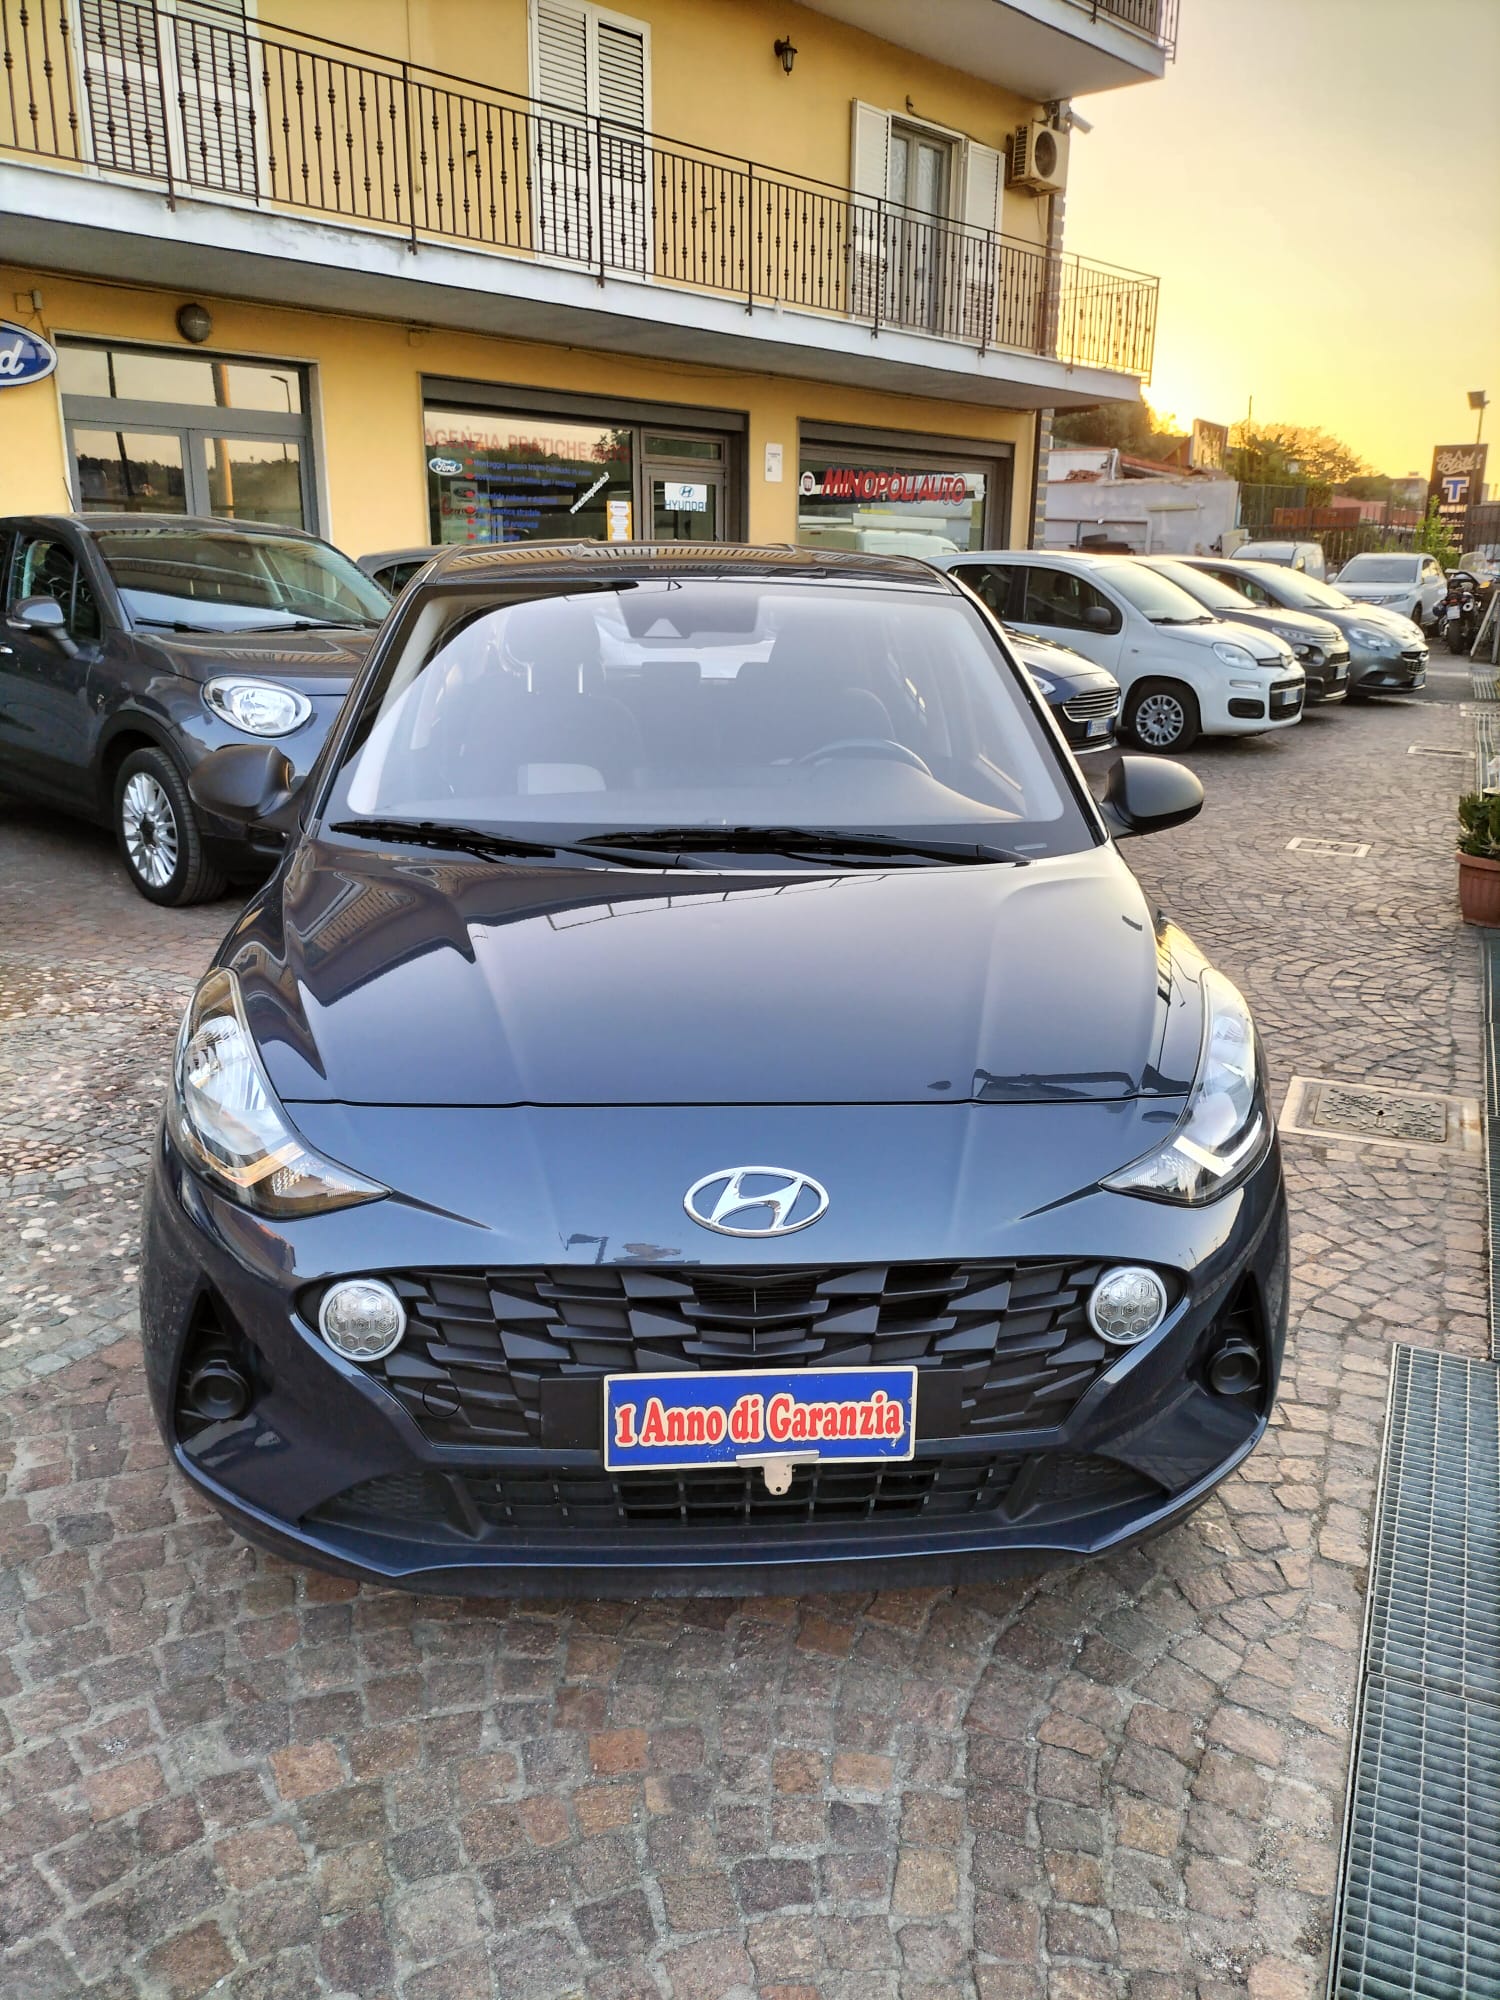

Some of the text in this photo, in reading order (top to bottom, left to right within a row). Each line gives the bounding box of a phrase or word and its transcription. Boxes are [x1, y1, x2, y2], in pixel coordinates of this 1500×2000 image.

[424, 428, 500, 451] AGENZIA
[508, 434, 588, 461] PRATICHE
[821, 466, 916, 502] MINOPOLI
[917, 473, 966, 504] AUTO
[665, 500, 707, 512] HYUNDAI
[616, 1393, 902, 1445] 1 Anno di Garanzia
